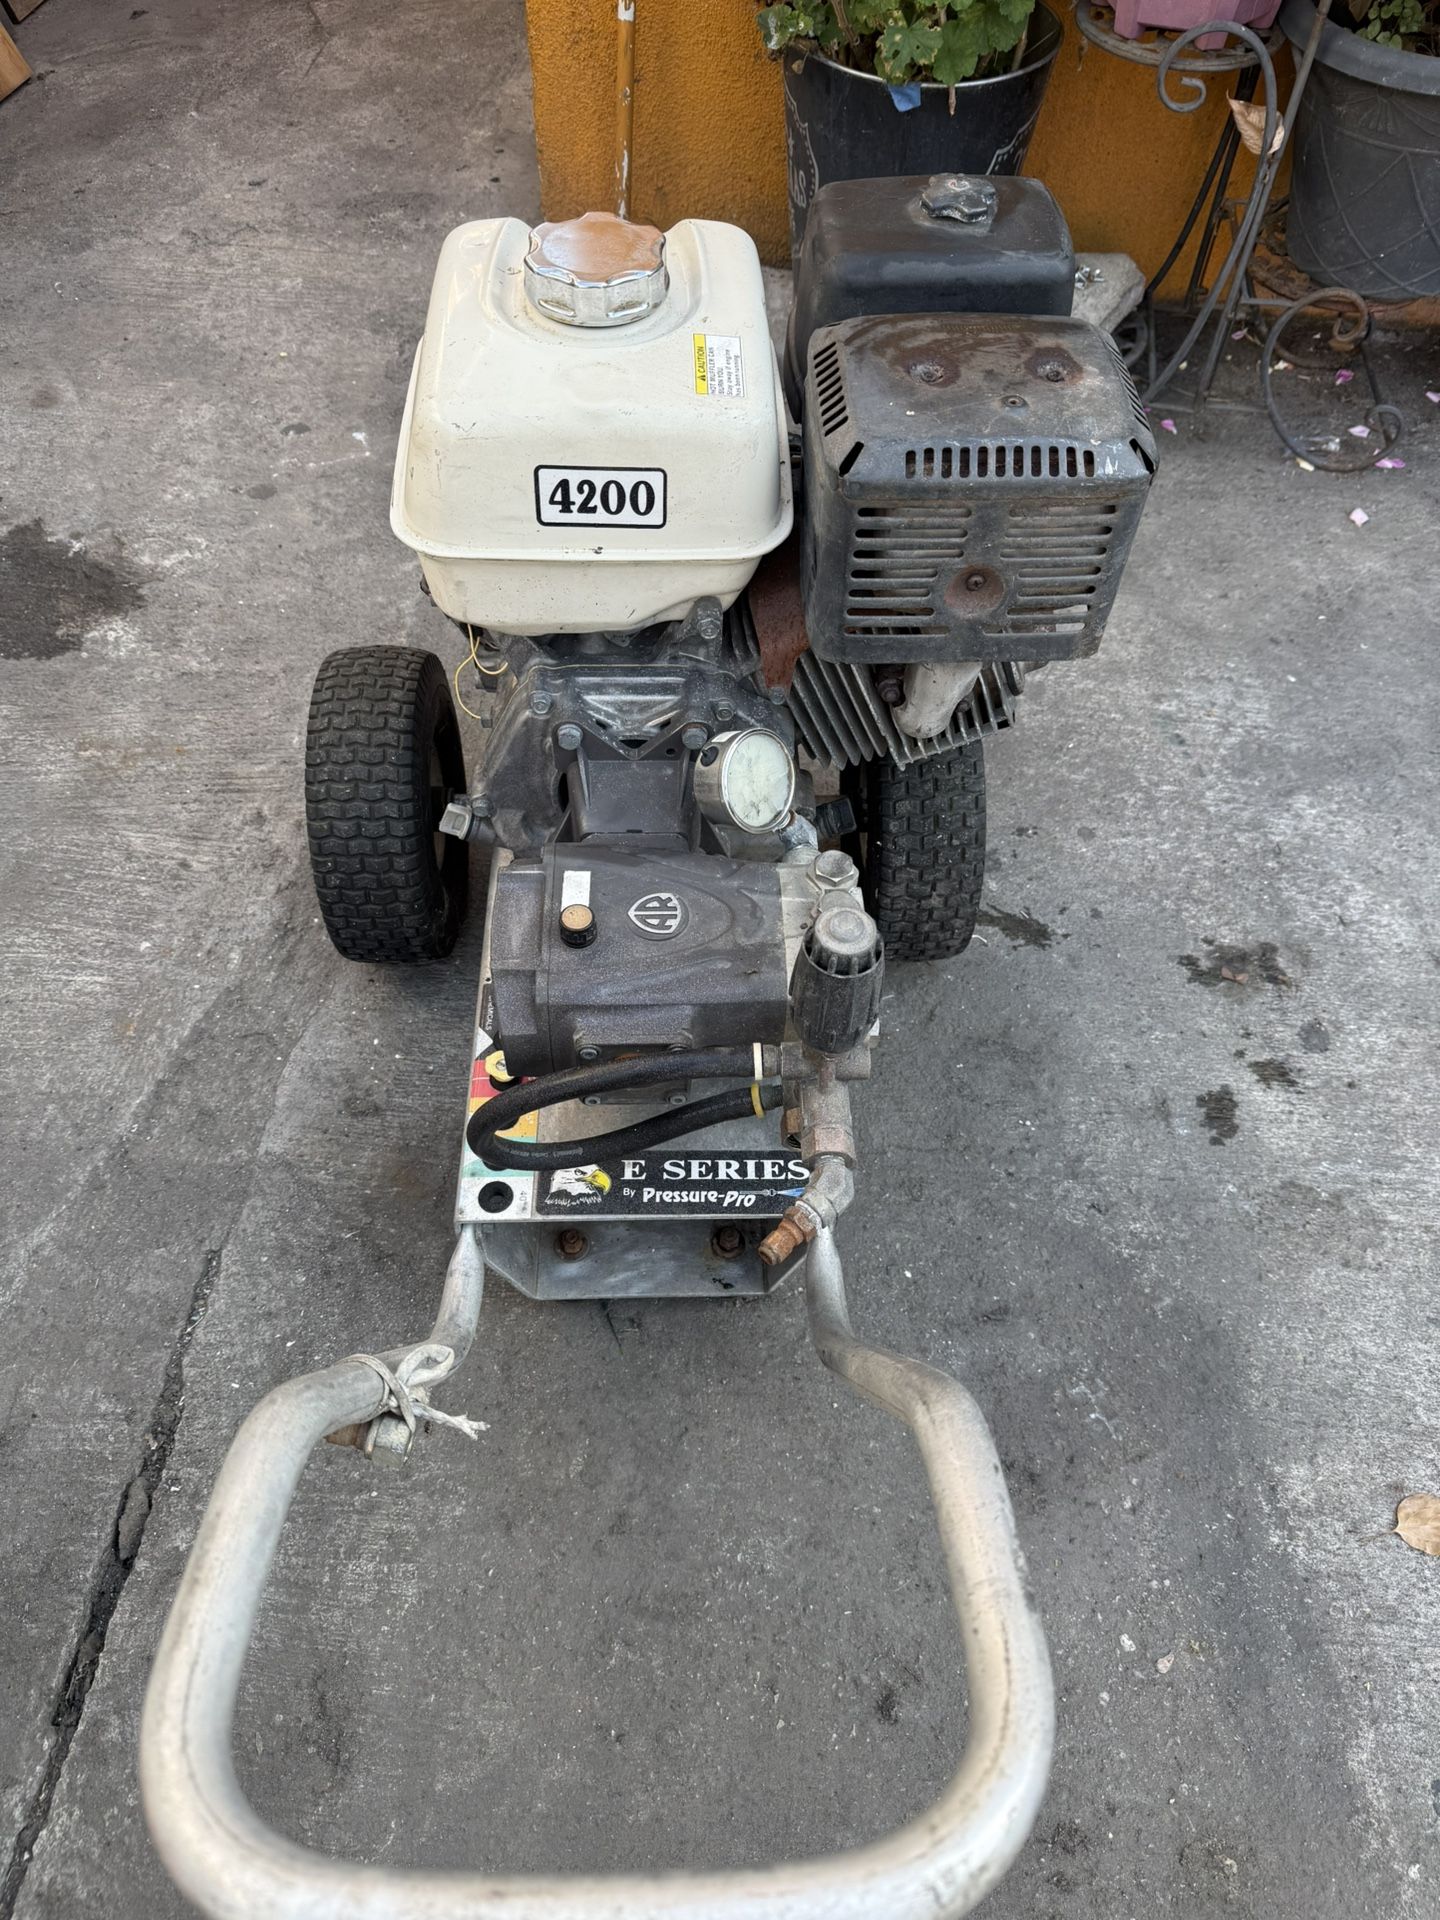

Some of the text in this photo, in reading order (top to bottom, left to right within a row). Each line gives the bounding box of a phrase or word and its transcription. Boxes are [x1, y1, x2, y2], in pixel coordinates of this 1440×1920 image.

[697, 346, 705, 373] CAUTION
[549, 479, 655, 516] 4200
[620, 1160, 810, 1180] E SERIES
[623, 1187, 756, 1207] By Pressure-Pro
